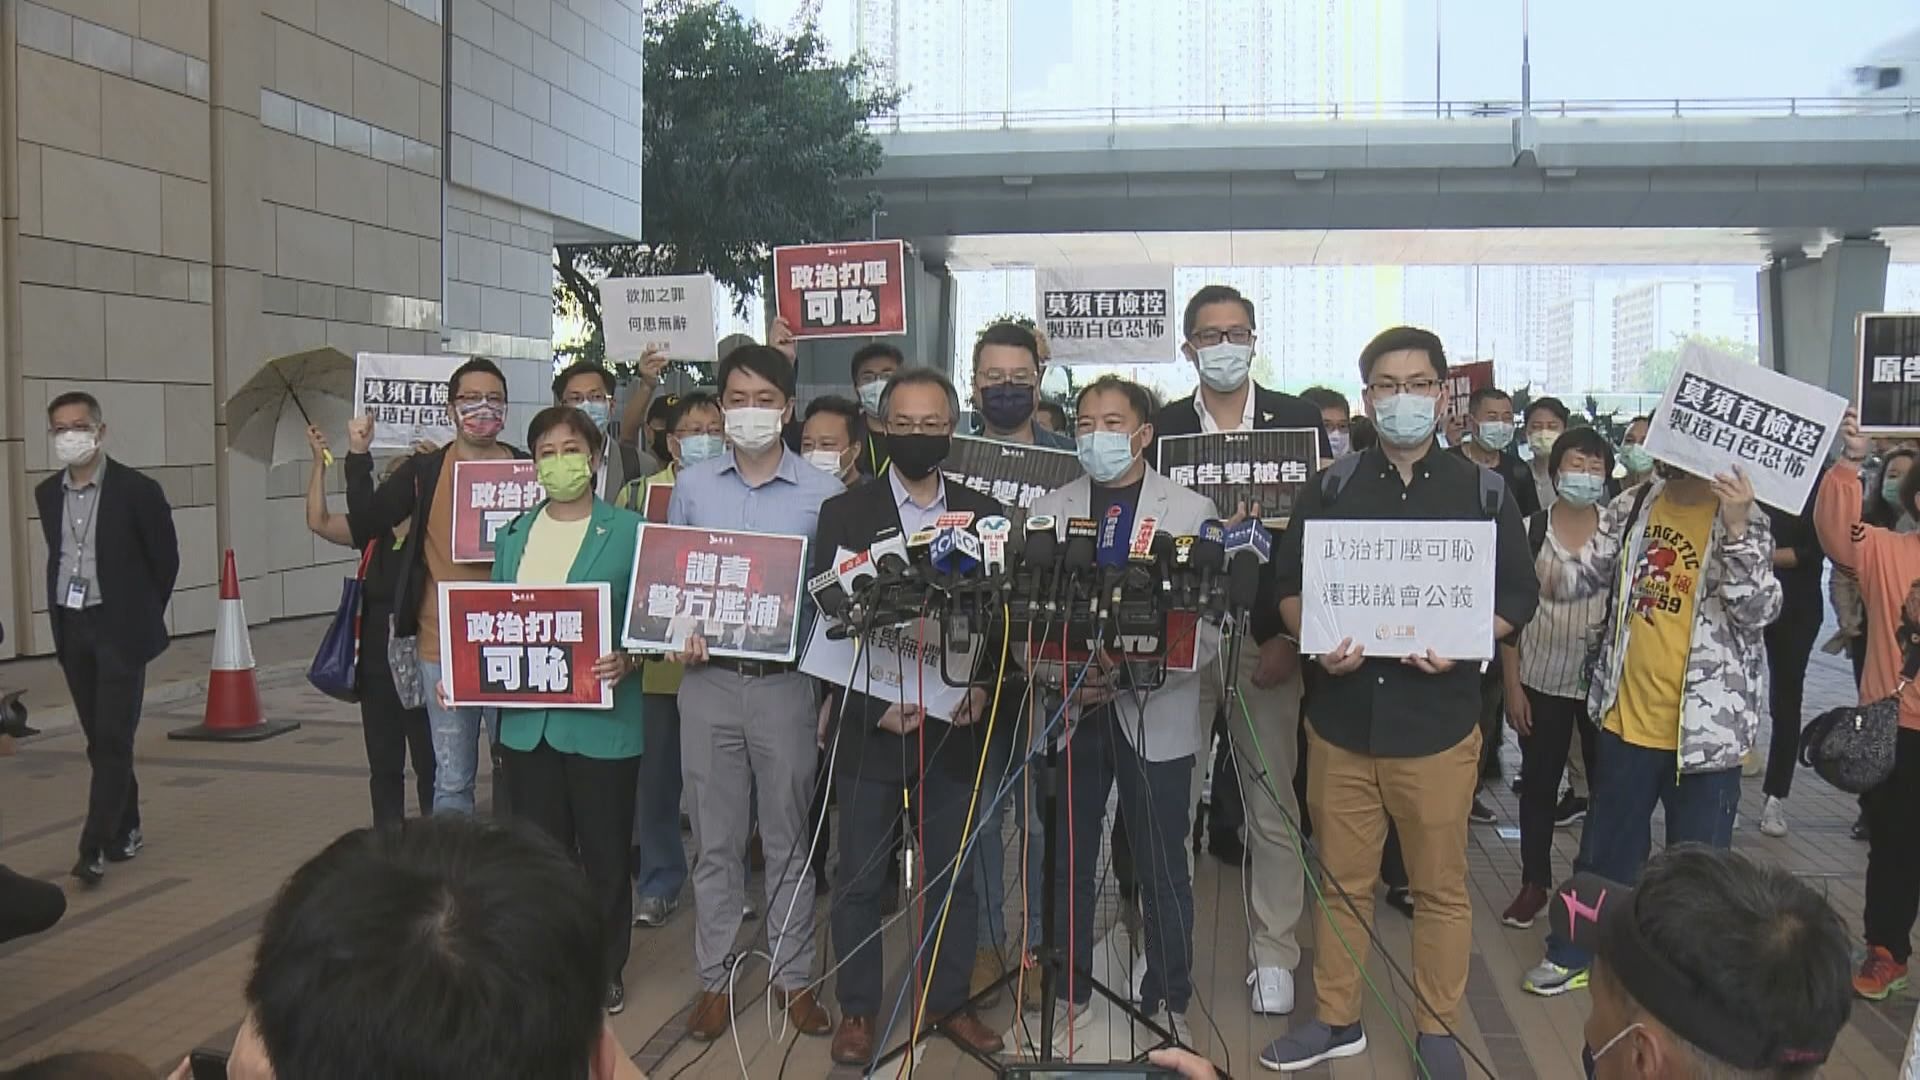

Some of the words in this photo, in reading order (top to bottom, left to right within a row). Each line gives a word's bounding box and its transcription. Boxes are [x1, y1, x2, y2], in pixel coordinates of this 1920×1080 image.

[791, 261, 887, 290] 政治打壓
[626, 287, 685, 304] 欲加之罪
[805, 289, 876, 326] 可恥
[1046, 291, 1164, 317] 莫須有檢控
[1047, 319, 1164, 339] 製造白色恐怖
[1678, 376, 1821, 453] 莫須有檢控
[1669, 409, 1808, 479] 製造白色恐怖
[1169, 461, 1307, 486] 原告變被告
[1325, 538, 1475, 562] 政治打壓可恥
[648, 583, 780, 628] 警方濫捕
[1323, 583, 1473, 608] 還我議會公義
[1656, 595, 1682, 614] 59
[466, 611, 583, 643] 政治打壓
[483, 646, 569, 692] 可恥
